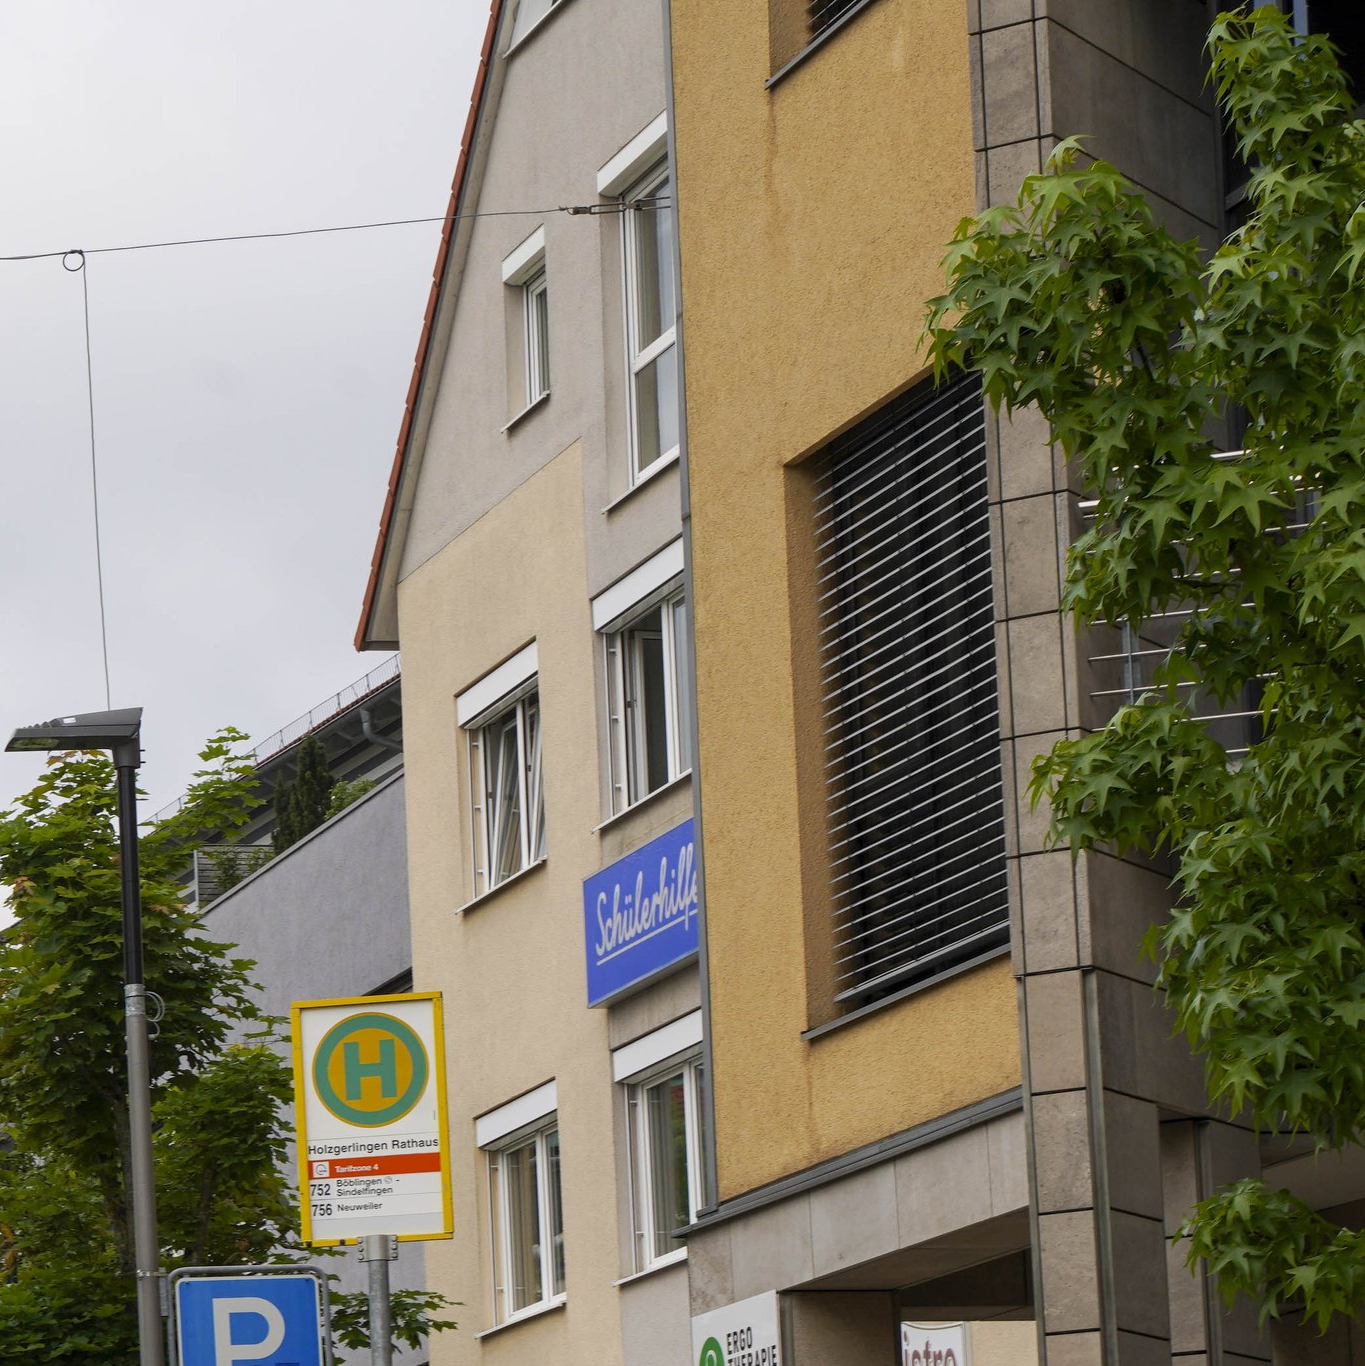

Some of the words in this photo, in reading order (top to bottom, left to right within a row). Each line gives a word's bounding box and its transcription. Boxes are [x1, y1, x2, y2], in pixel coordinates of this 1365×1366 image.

[343, 1038, 397, 1101] H
[308, 1142, 388, 1156] Holzgerlingen
[391, 1137, 439, 1150] Rathaus
[334, 1163, 372, 1173] Tarifzone
[372, 1163, 380, 1171] 4
[336, 1177, 383, 1188] Böblingen
[310, 1183, 331, 1197] 752
[336, 1186, 394, 1197] Sindelfingen
[311, 1203, 333, 1217] 756
[337, 1202, 383, 1212] Neuweiler
[726, 1326, 753, 1356] ERGO
